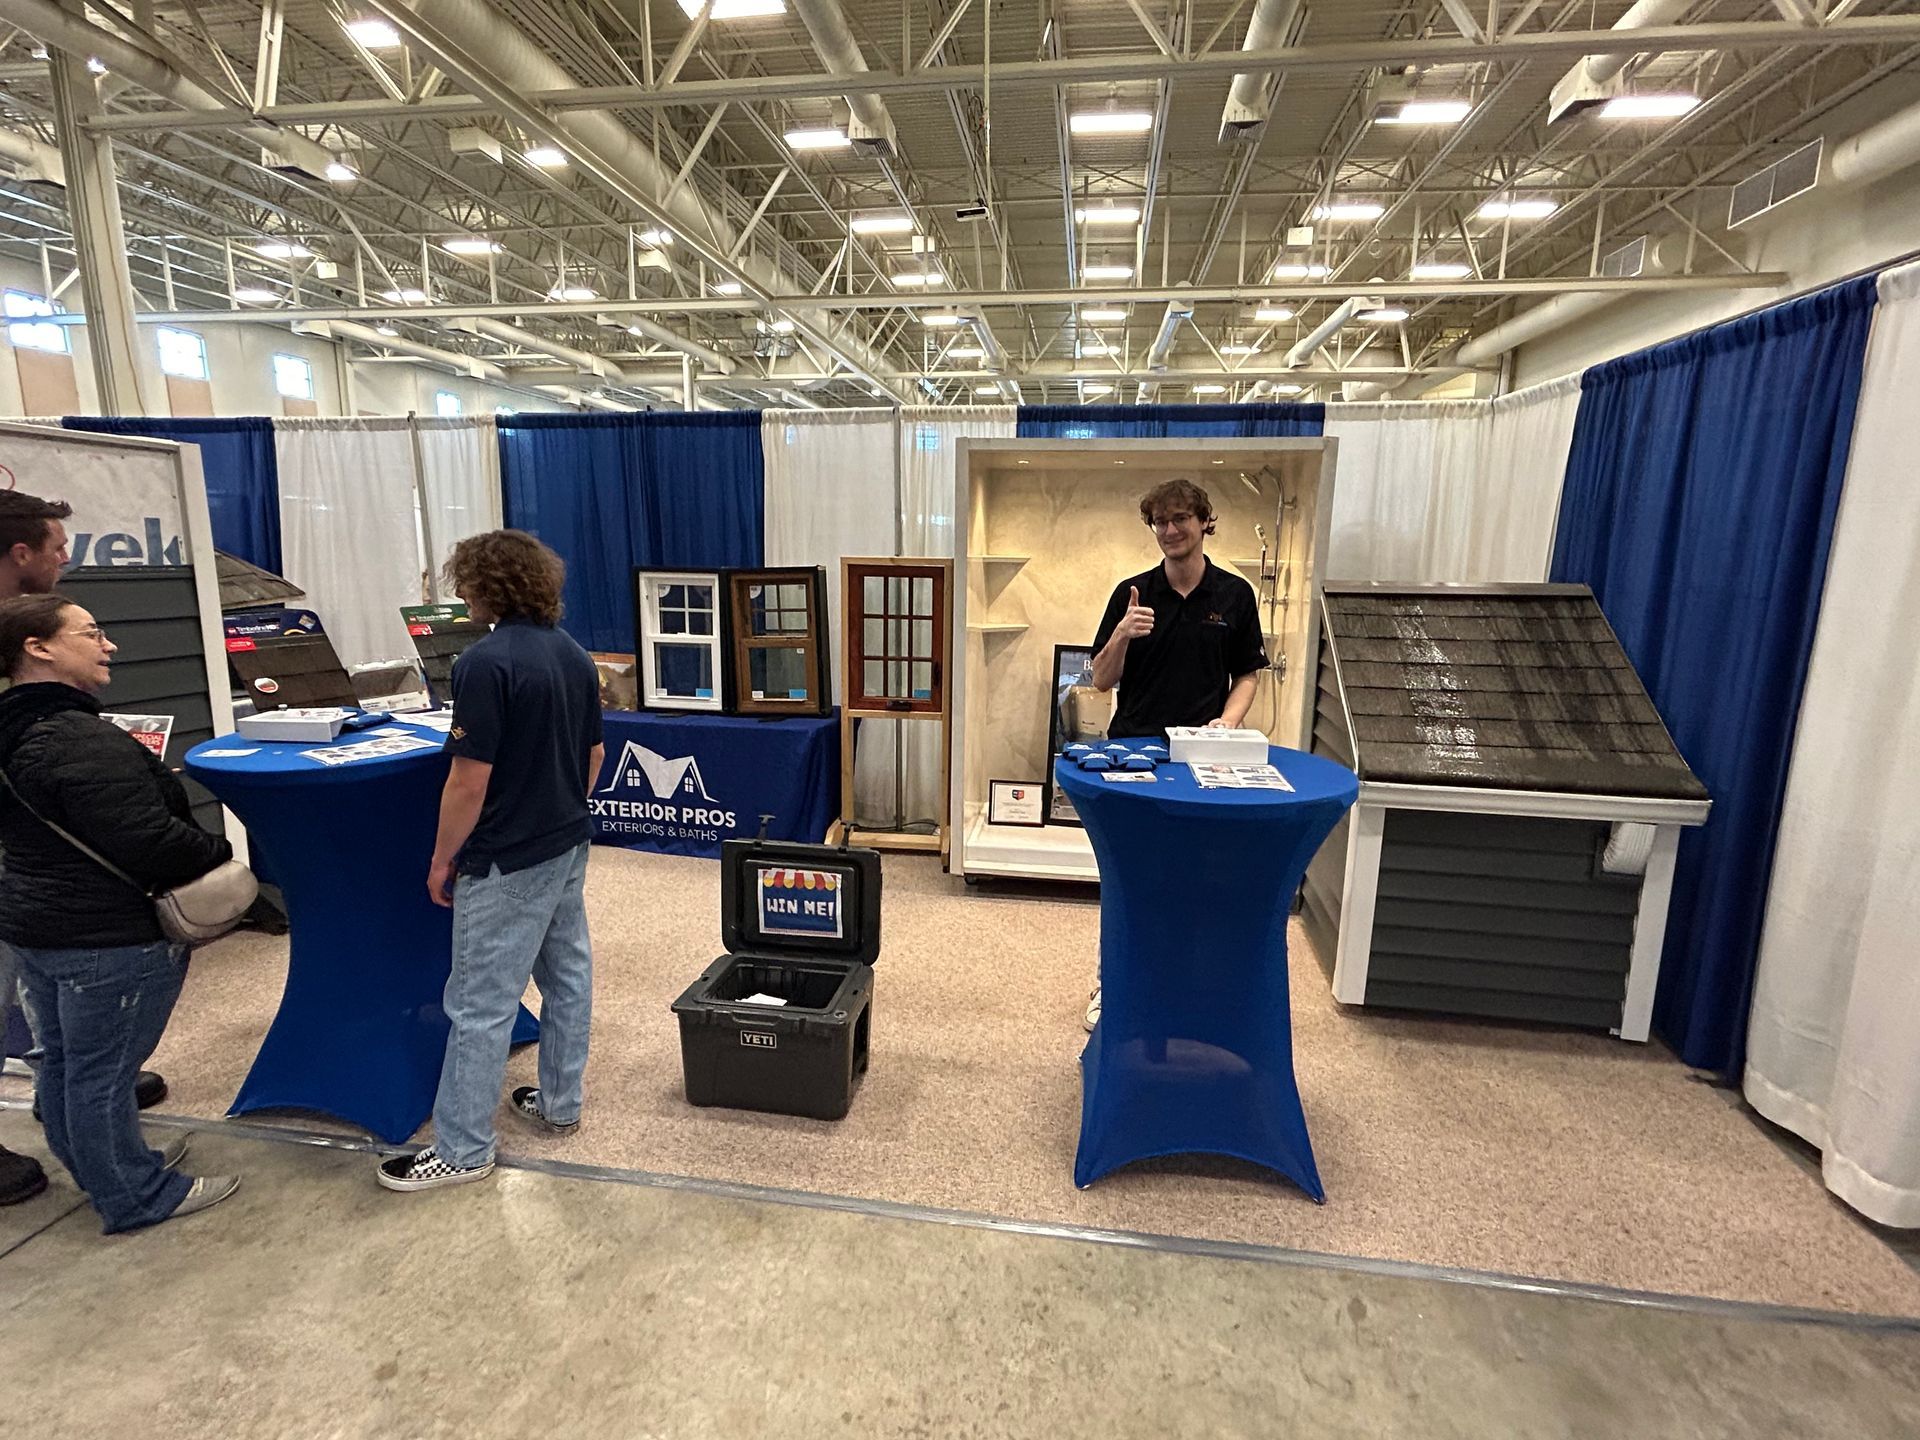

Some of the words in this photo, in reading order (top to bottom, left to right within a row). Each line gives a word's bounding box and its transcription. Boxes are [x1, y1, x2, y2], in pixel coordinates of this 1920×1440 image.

[683, 807, 736, 828] PROS
[602, 821, 664, 836] EXTERIORS
[667, 827, 677, 837] &
[679, 828, 718, 841] BATHS
[766, 898, 798, 914] WIN
[804, 900, 834, 920] ME!
[743, 1032, 774, 1046] YETI
